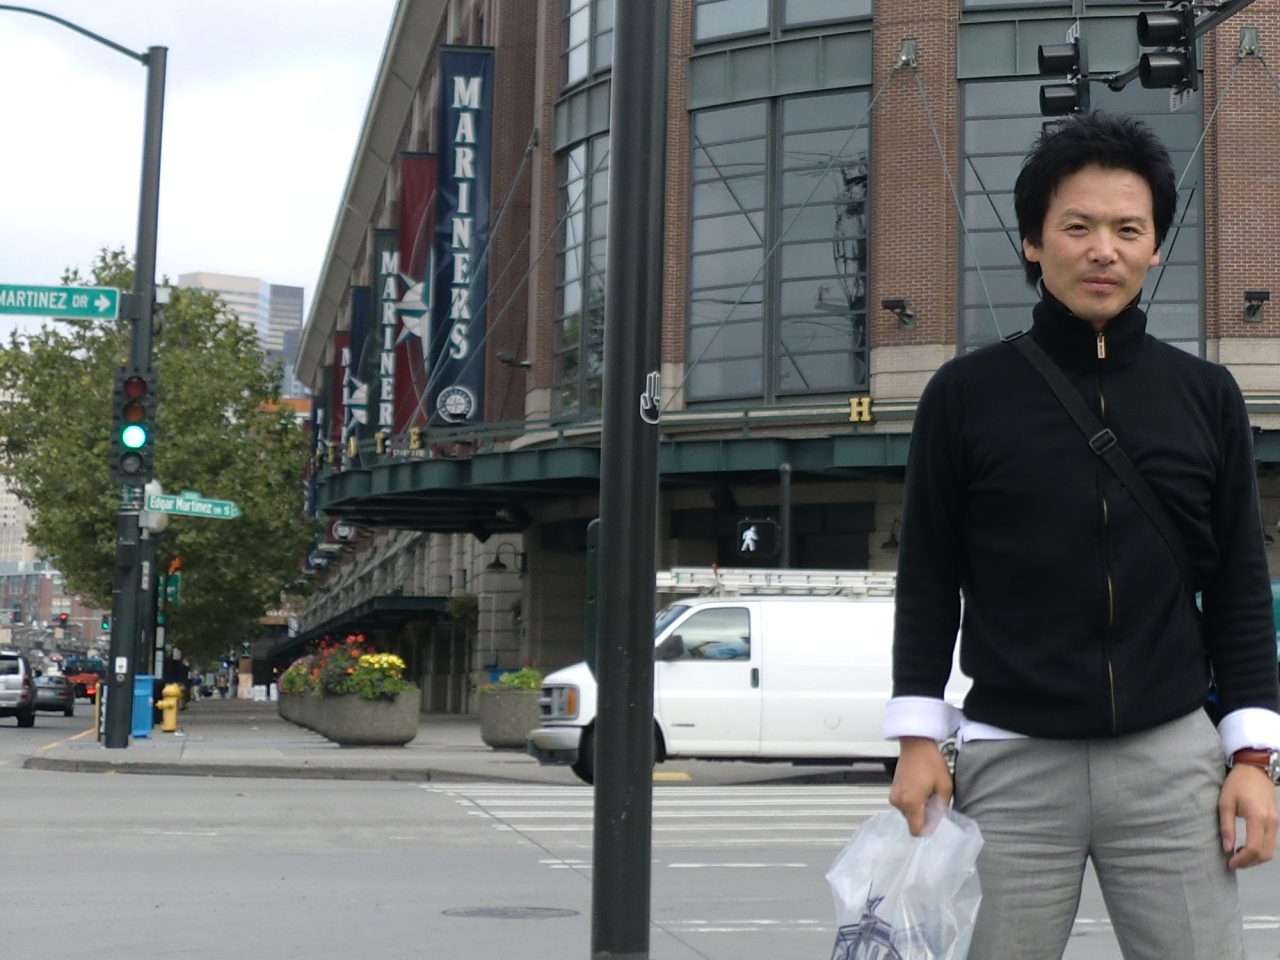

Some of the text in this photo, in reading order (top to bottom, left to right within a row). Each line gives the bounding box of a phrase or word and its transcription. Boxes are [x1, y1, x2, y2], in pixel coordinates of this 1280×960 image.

[450, 76, 482, 361] MARINERS
[0, 289, 88, 309] MARTINEZ DR
[378, 251, 399, 438] MARINER
[150, 496, 174, 511] Edgar
[176, 498, 213, 514] Martinez
